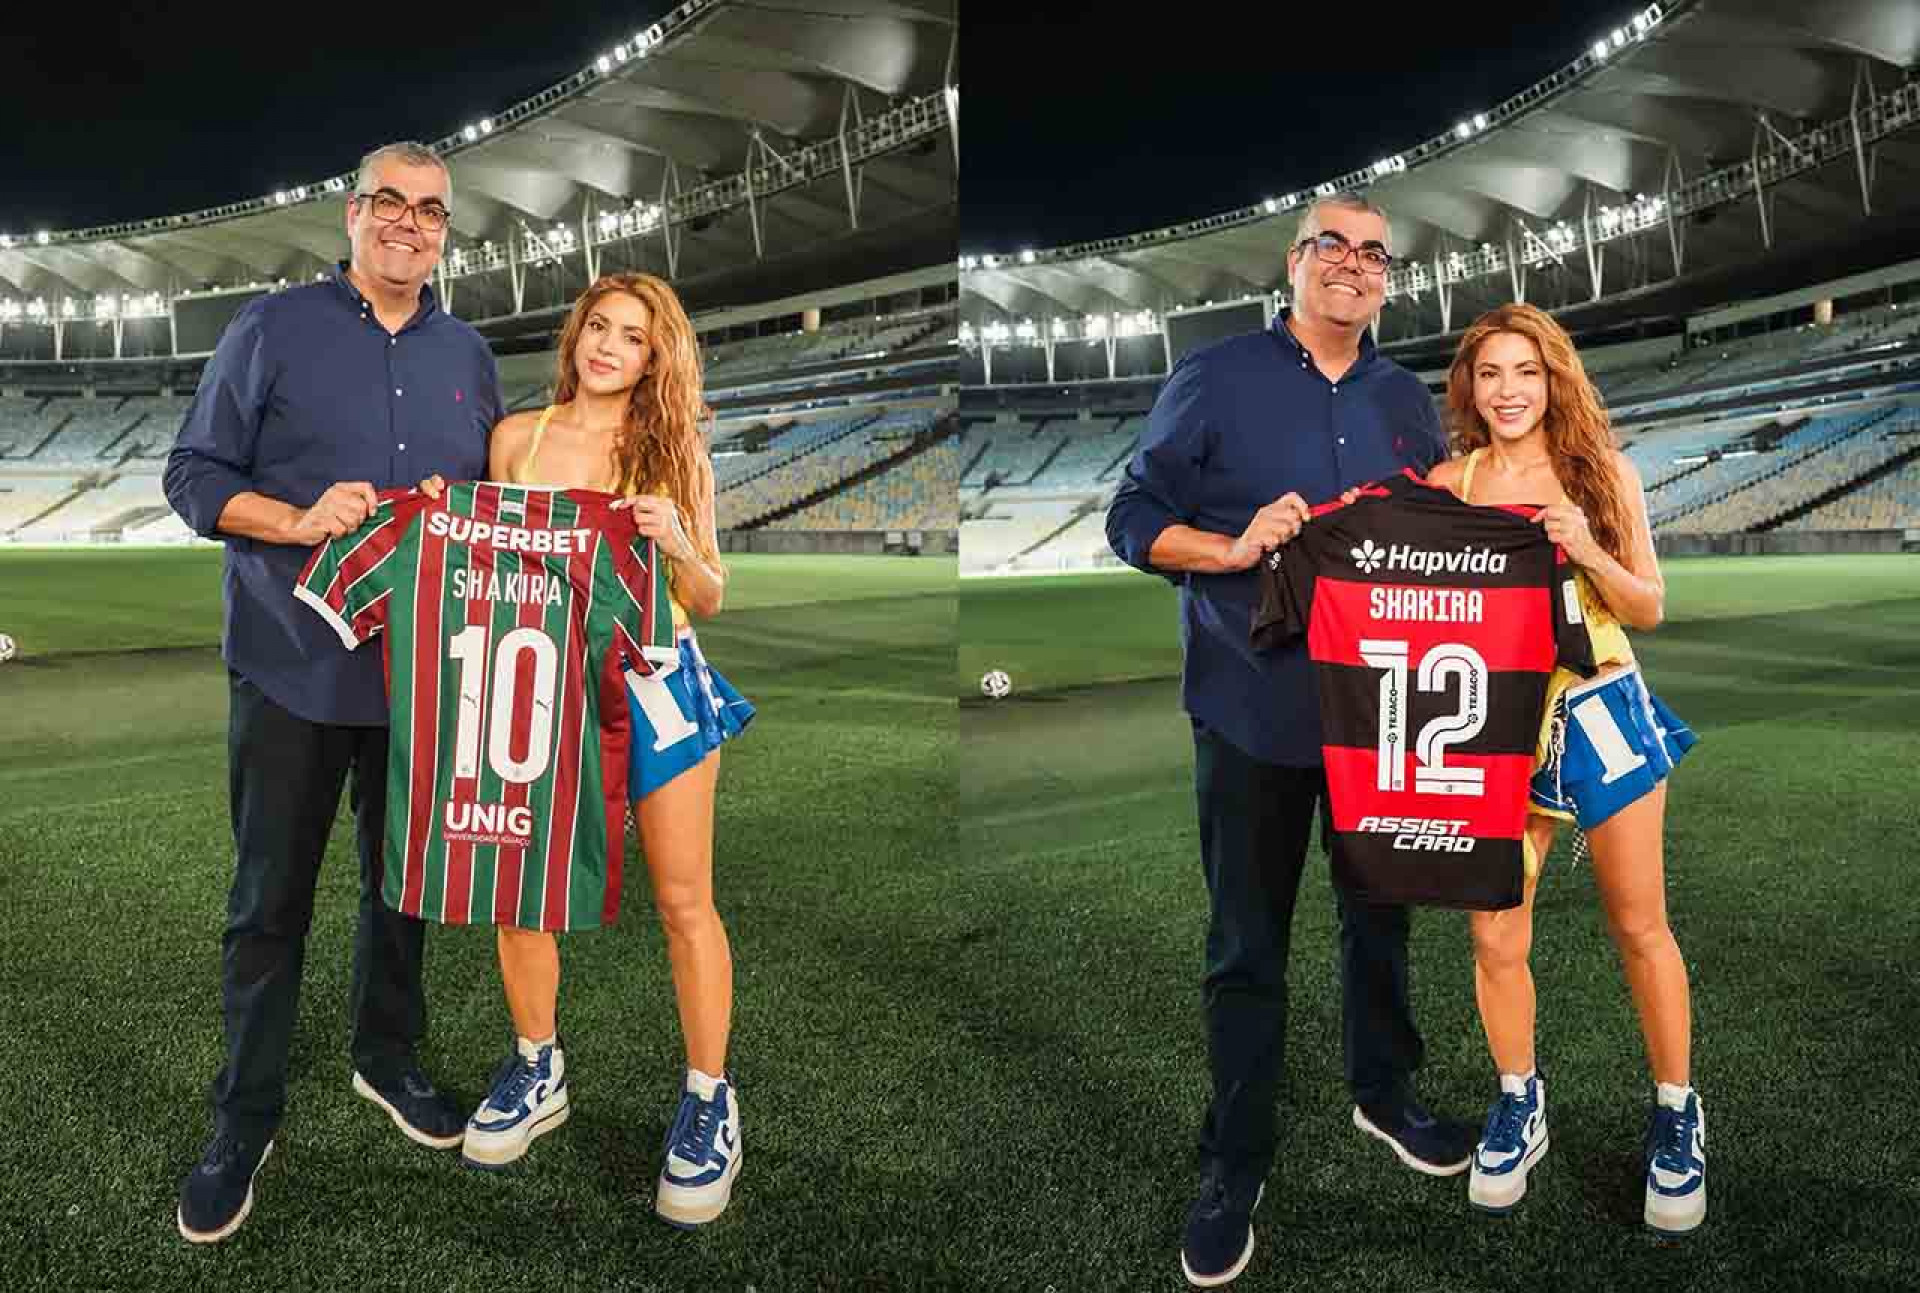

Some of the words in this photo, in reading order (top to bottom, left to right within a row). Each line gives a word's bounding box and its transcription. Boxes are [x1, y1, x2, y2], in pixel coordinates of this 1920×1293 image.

[427, 512, 591, 553] SUPERBET
[1387, 545, 1507, 576] Hapvida
[453, 569, 562, 605] SHAKIRA
[1369, 587, 1483, 623] SHAKIRA
[450, 625, 558, 783] 10
[1359, 639, 1488, 796] 12
[446, 802, 532, 836] UNIG
[1357, 816, 1470, 836] ASSIST
[1393, 834, 1476, 852] CARD
